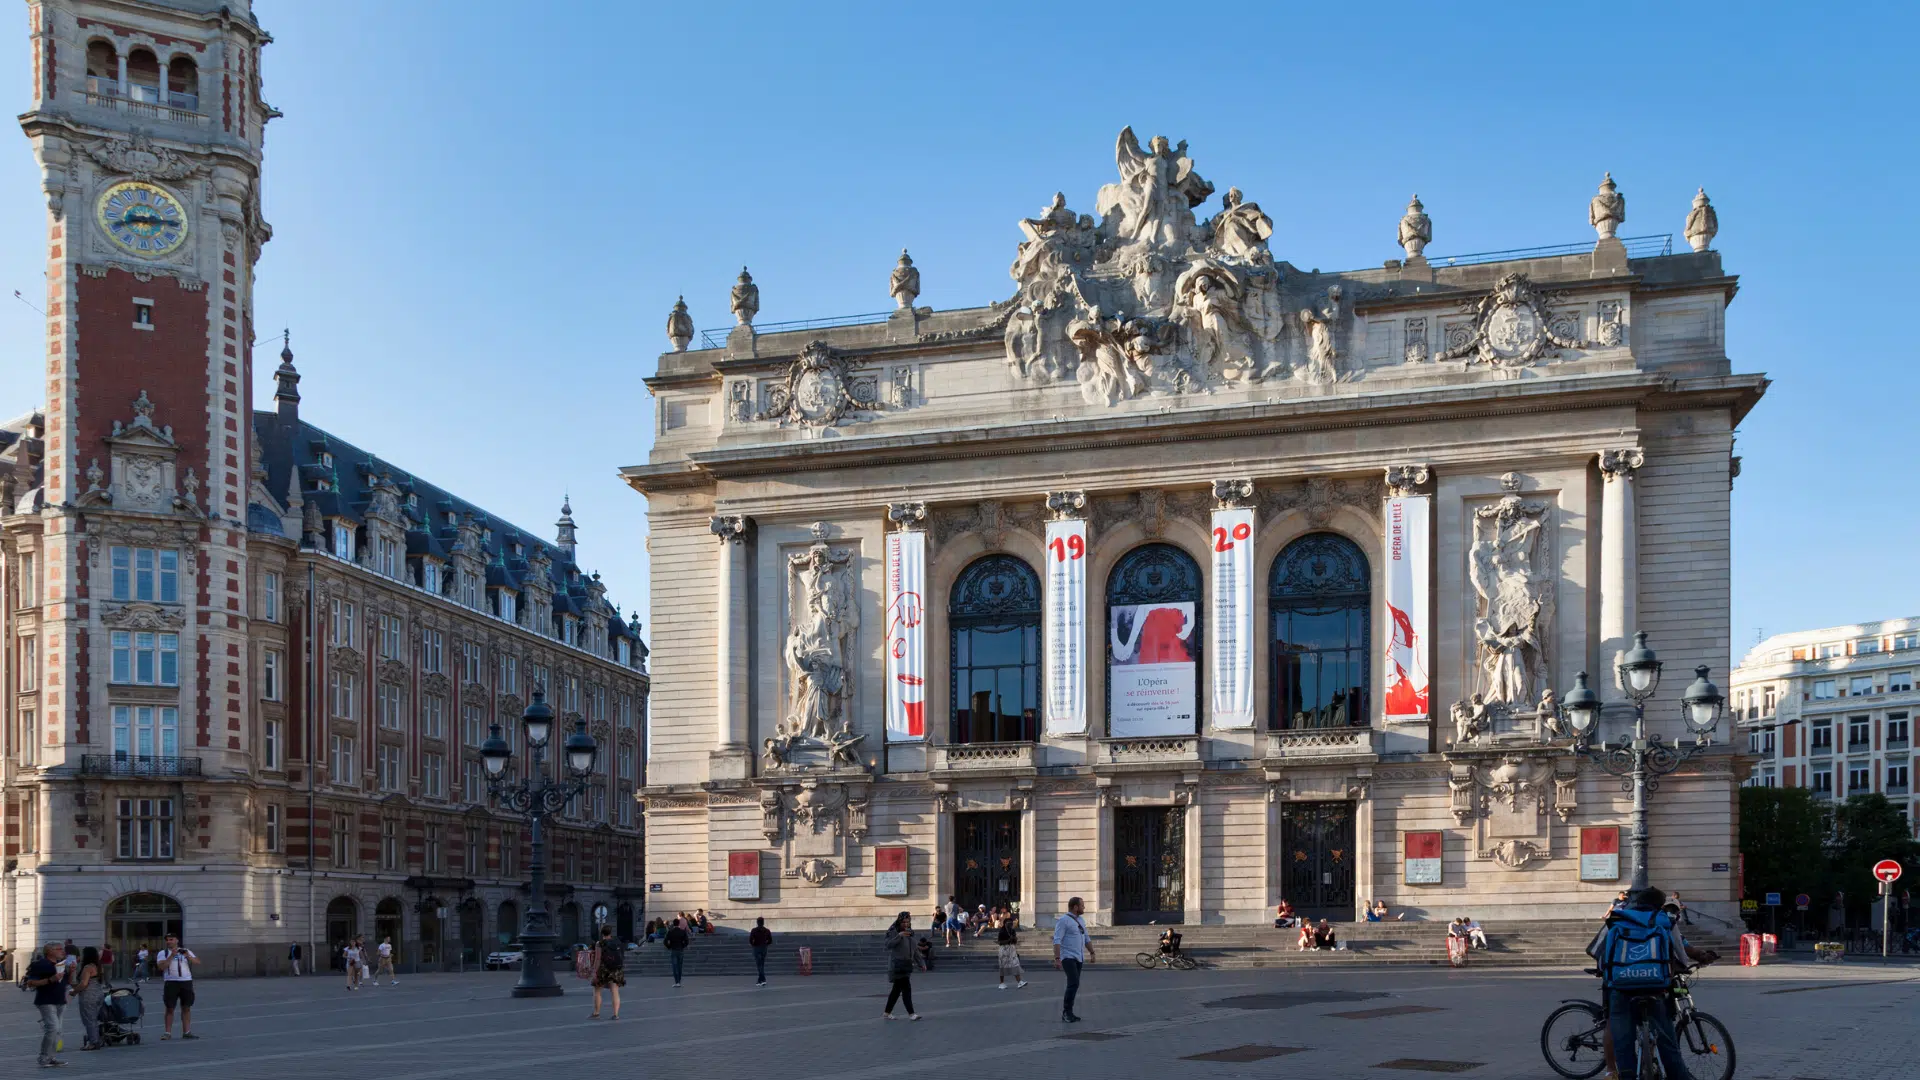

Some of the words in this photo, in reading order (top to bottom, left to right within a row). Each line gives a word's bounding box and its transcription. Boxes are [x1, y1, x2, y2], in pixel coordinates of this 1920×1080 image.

[1392, 503, 1402, 523] LILLE
[1213, 523, 1251, 552] 20
[1392, 525, 1402, 534] DE
[892, 538, 900, 556] LILLE
[1049, 534, 1085, 563] 19
[1392, 536, 1402, 561] OPÉRA
[892, 558, 900, 567] DE
[892, 568, 900, 592] OPÉRA
[1136, 688, 1175, 696] réinvente
[1619, 967, 1658, 978] stuart
